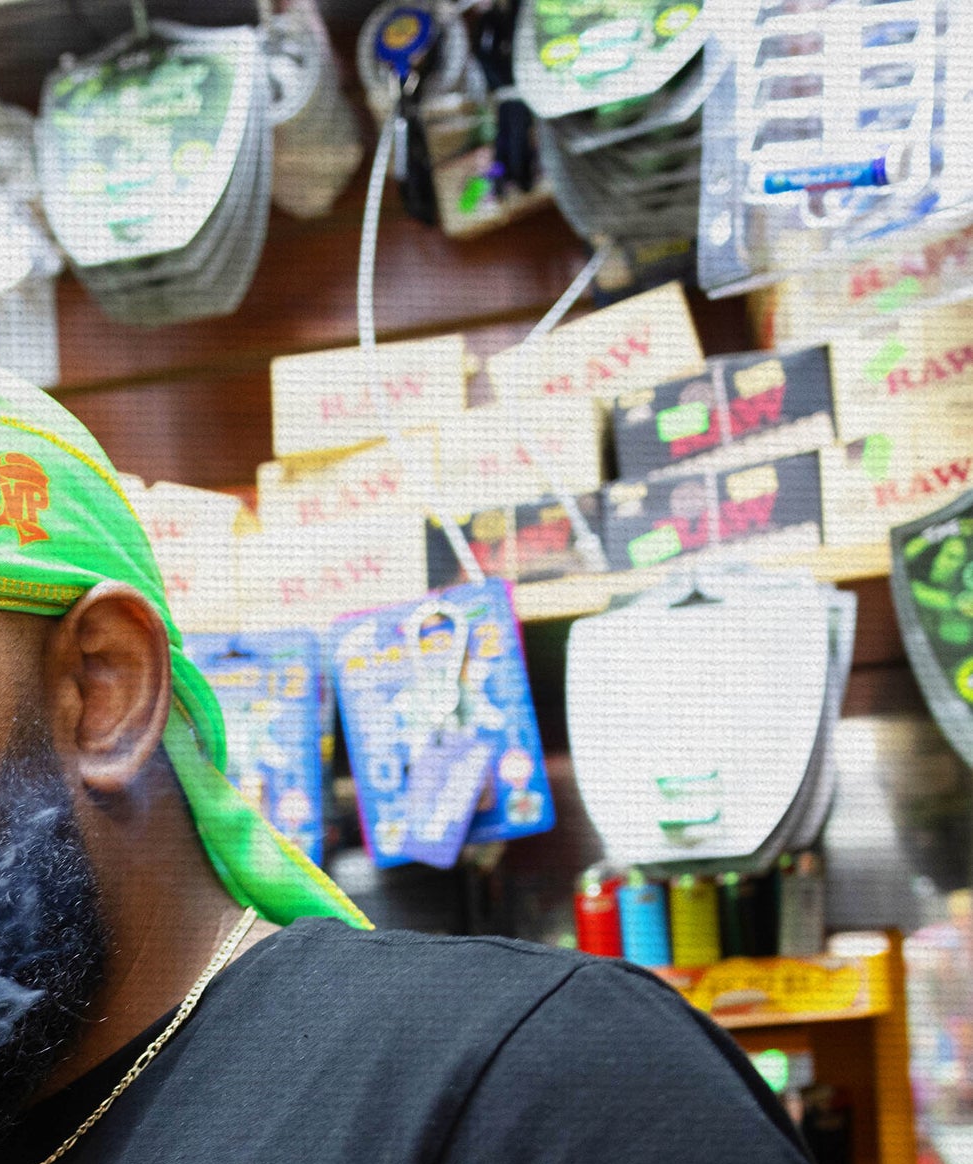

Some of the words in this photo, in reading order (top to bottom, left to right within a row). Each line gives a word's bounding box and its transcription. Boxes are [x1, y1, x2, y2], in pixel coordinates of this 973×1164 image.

[295, 464, 399, 526] RAW
[873, 458, 972, 506] RAW
[277, 550, 385, 605] RAW
